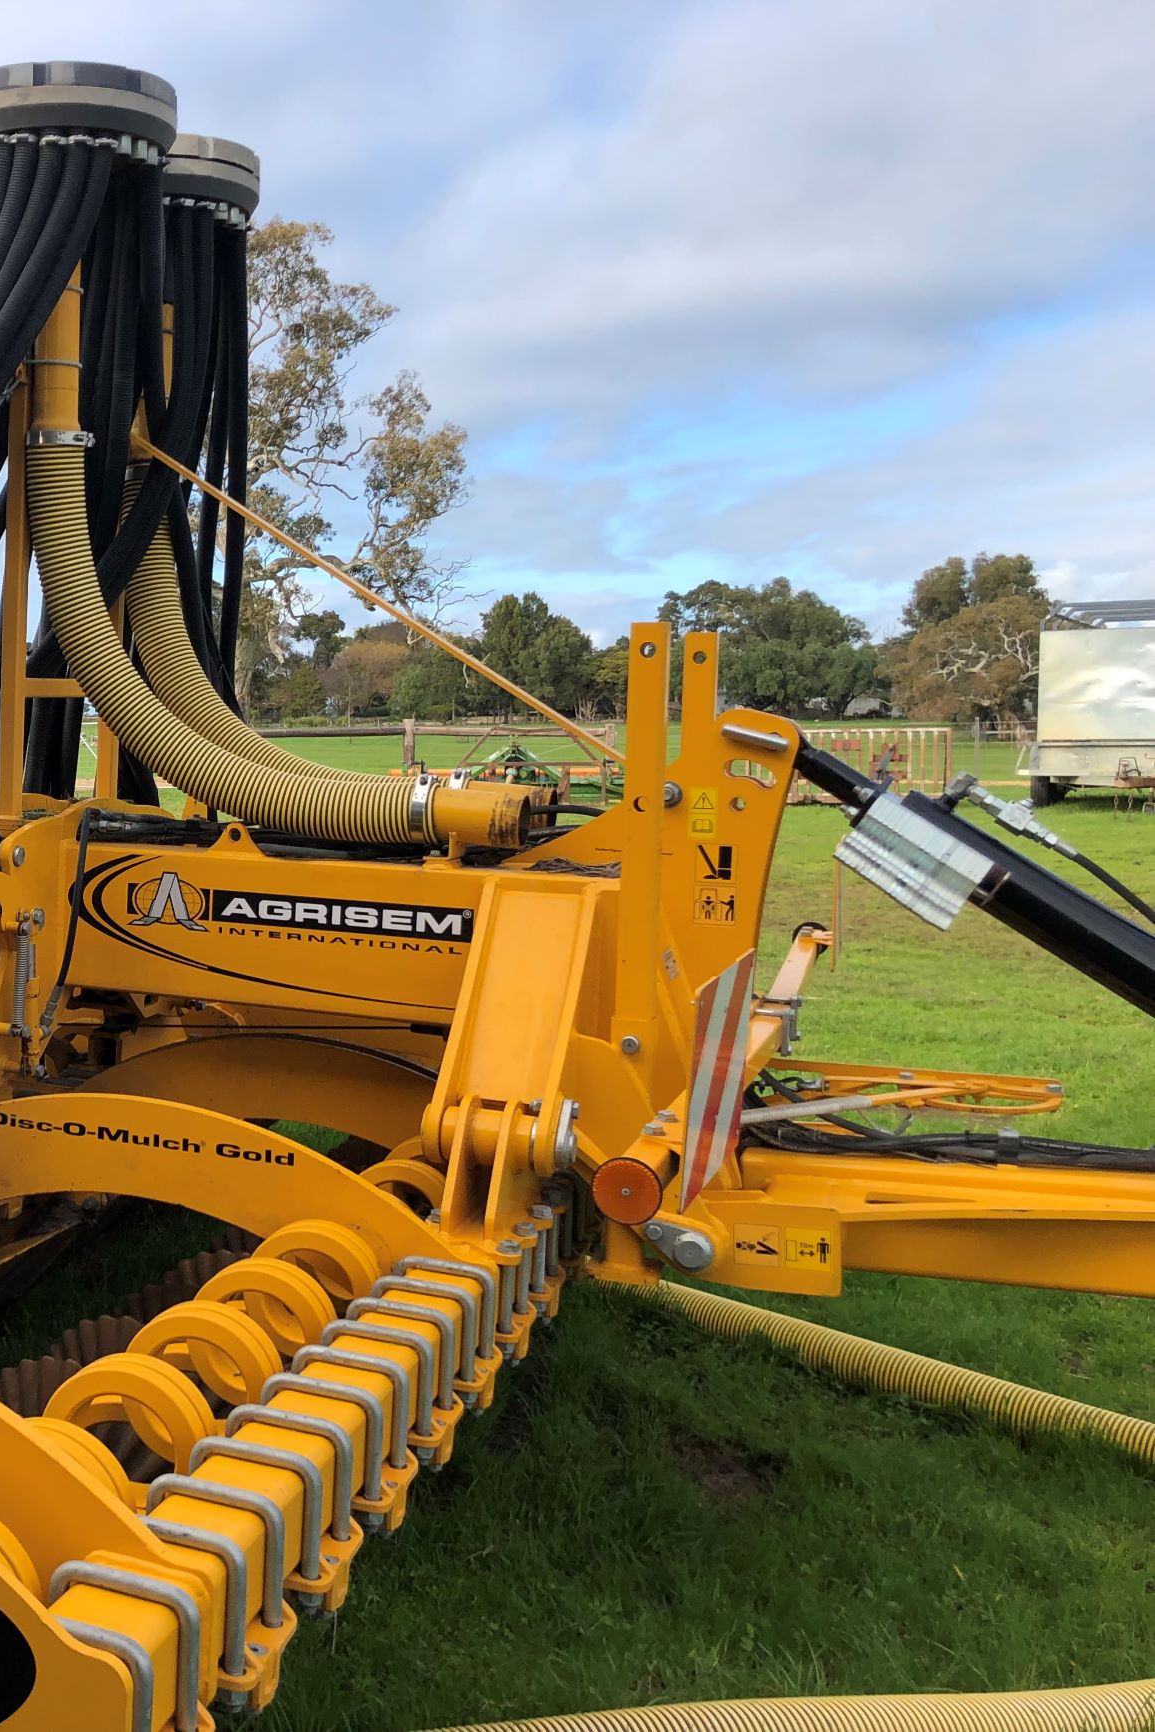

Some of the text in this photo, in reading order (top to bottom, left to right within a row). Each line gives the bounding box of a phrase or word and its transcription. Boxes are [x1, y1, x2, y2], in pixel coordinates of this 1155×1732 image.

[221, 897, 463, 935] AGRISEM
[217, 926, 463, 955] INTERNATIONAL
[215, 1143, 295, 1167] Gold
